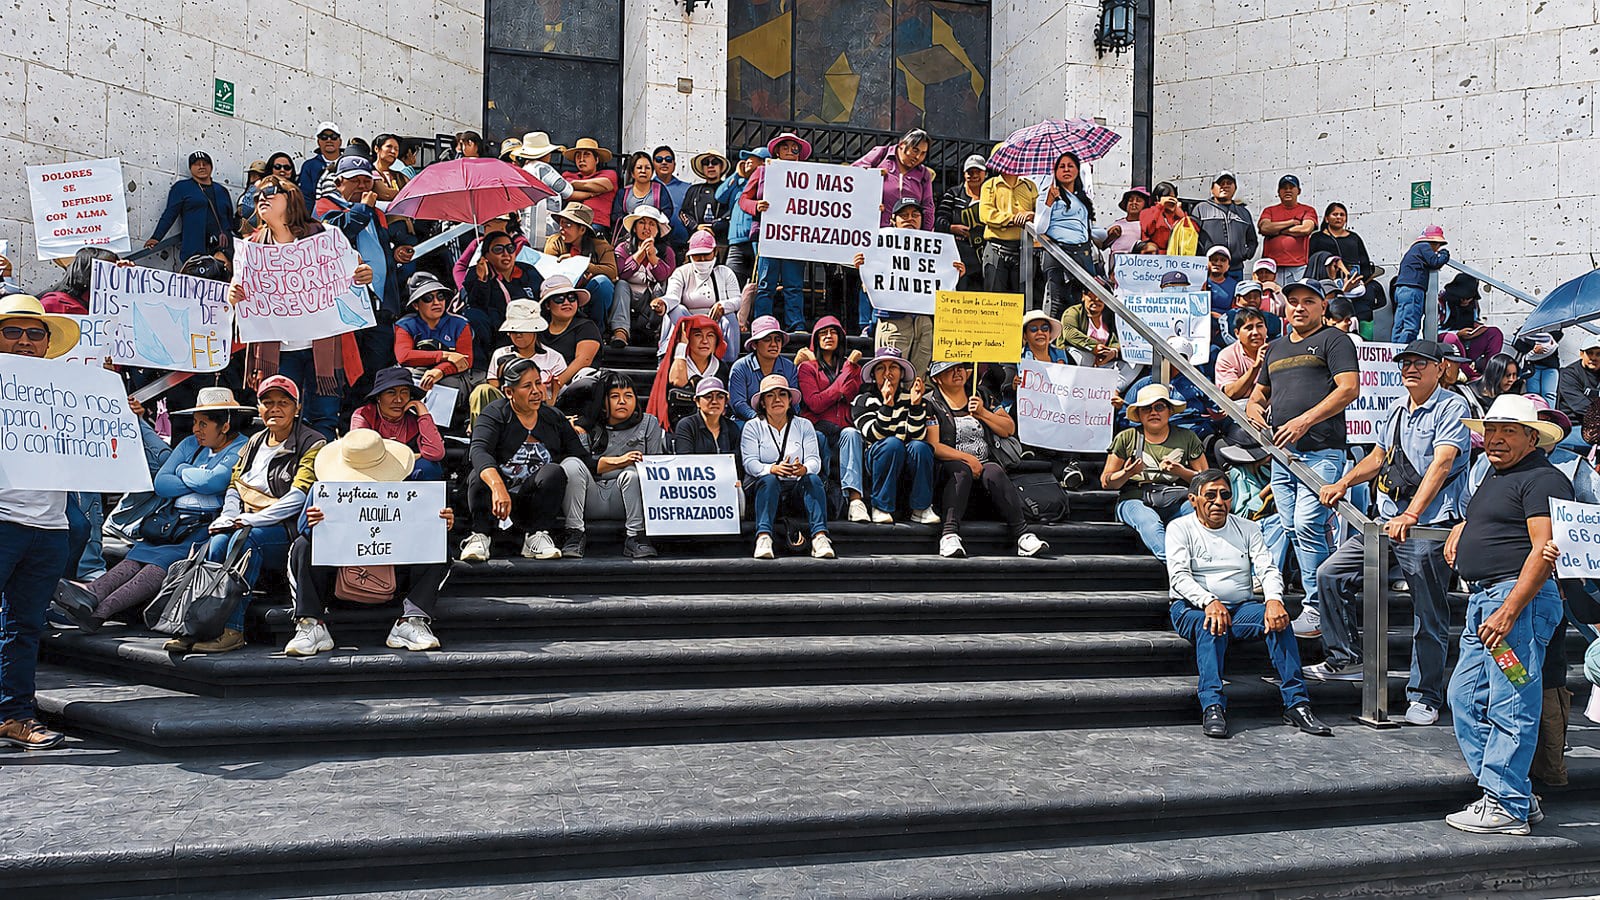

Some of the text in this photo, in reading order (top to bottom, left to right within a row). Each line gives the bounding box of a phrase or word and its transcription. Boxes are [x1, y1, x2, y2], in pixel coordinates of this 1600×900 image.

[42, 169, 93, 182] DOLORES
[786, 171, 854, 193] NO MAS
[62, 184, 77, 193] SE
[61, 194, 114, 208] DEFIENDE
[785, 197, 852, 219] ABUSOS
[46, 209, 108, 222] CON ALMA
[765, 223, 872, 248] DISFRAZADOS
[892, 255, 936, 274] NO SE
[1145, 296, 1187, 305] NUESTRA
[202, 305, 218, 325] DE
[85, 394, 122, 415] nos
[82, 416, 138, 441] papeles
[645, 466, 717, 481] NO MAS
[387, 489, 399, 499] no
[407, 489, 418, 501] se
[659, 485, 717, 500] ABUSOS
[648, 505, 735, 521] DISFRAZADOS
[1556, 506, 1573, 522] No
[370, 525, 381, 538] se
[1561, 552, 1582, 568] de
